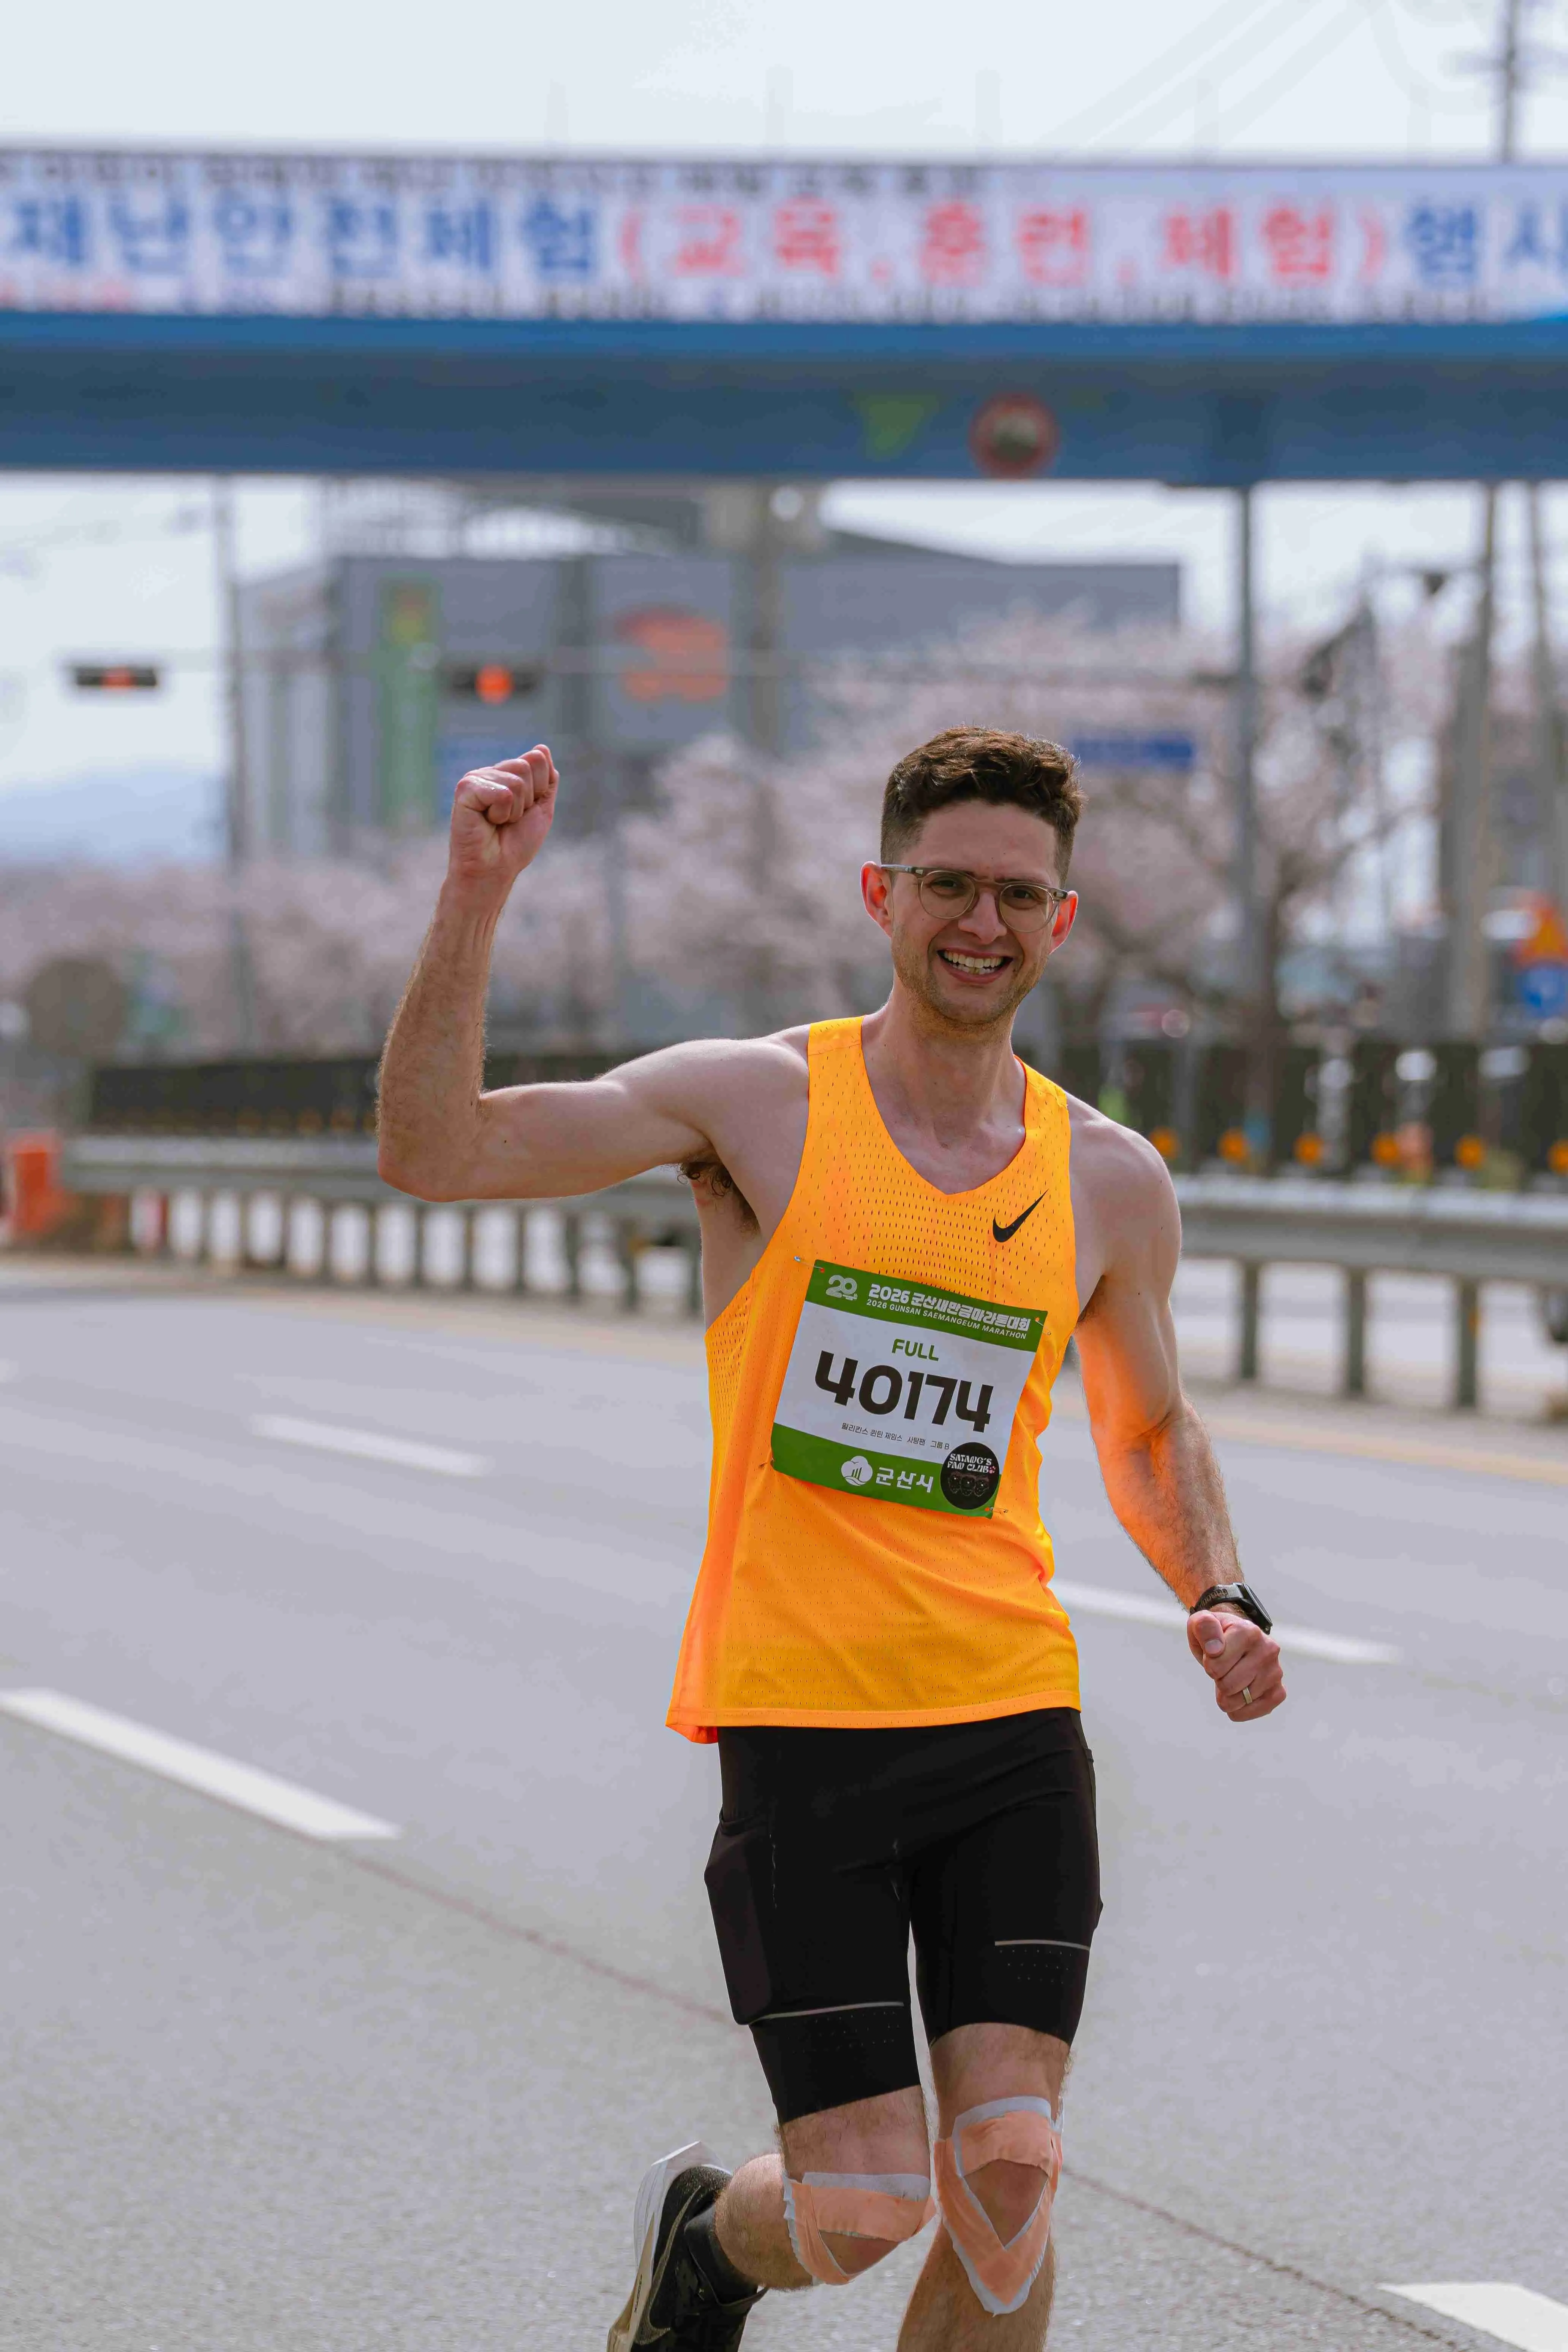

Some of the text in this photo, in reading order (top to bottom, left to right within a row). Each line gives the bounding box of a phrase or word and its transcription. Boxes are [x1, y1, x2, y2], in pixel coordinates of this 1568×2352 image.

[866, 1299, 1027, 1339] 2026 GUNSAN SAEMANGEUM MARATHON
[869, 1283, 1031, 1331] 2026 군산새만금마라톤대회
[891, 1338, 939, 1361] FULL
[815, 1350, 994, 1433] 40174
[884, 1432, 903, 1442] 제임스
[930, 1440, 943, 1449] 그룹
[876, 1467, 934, 1493] 군산시
[947, 1461, 989, 1473] FAN CLUB
